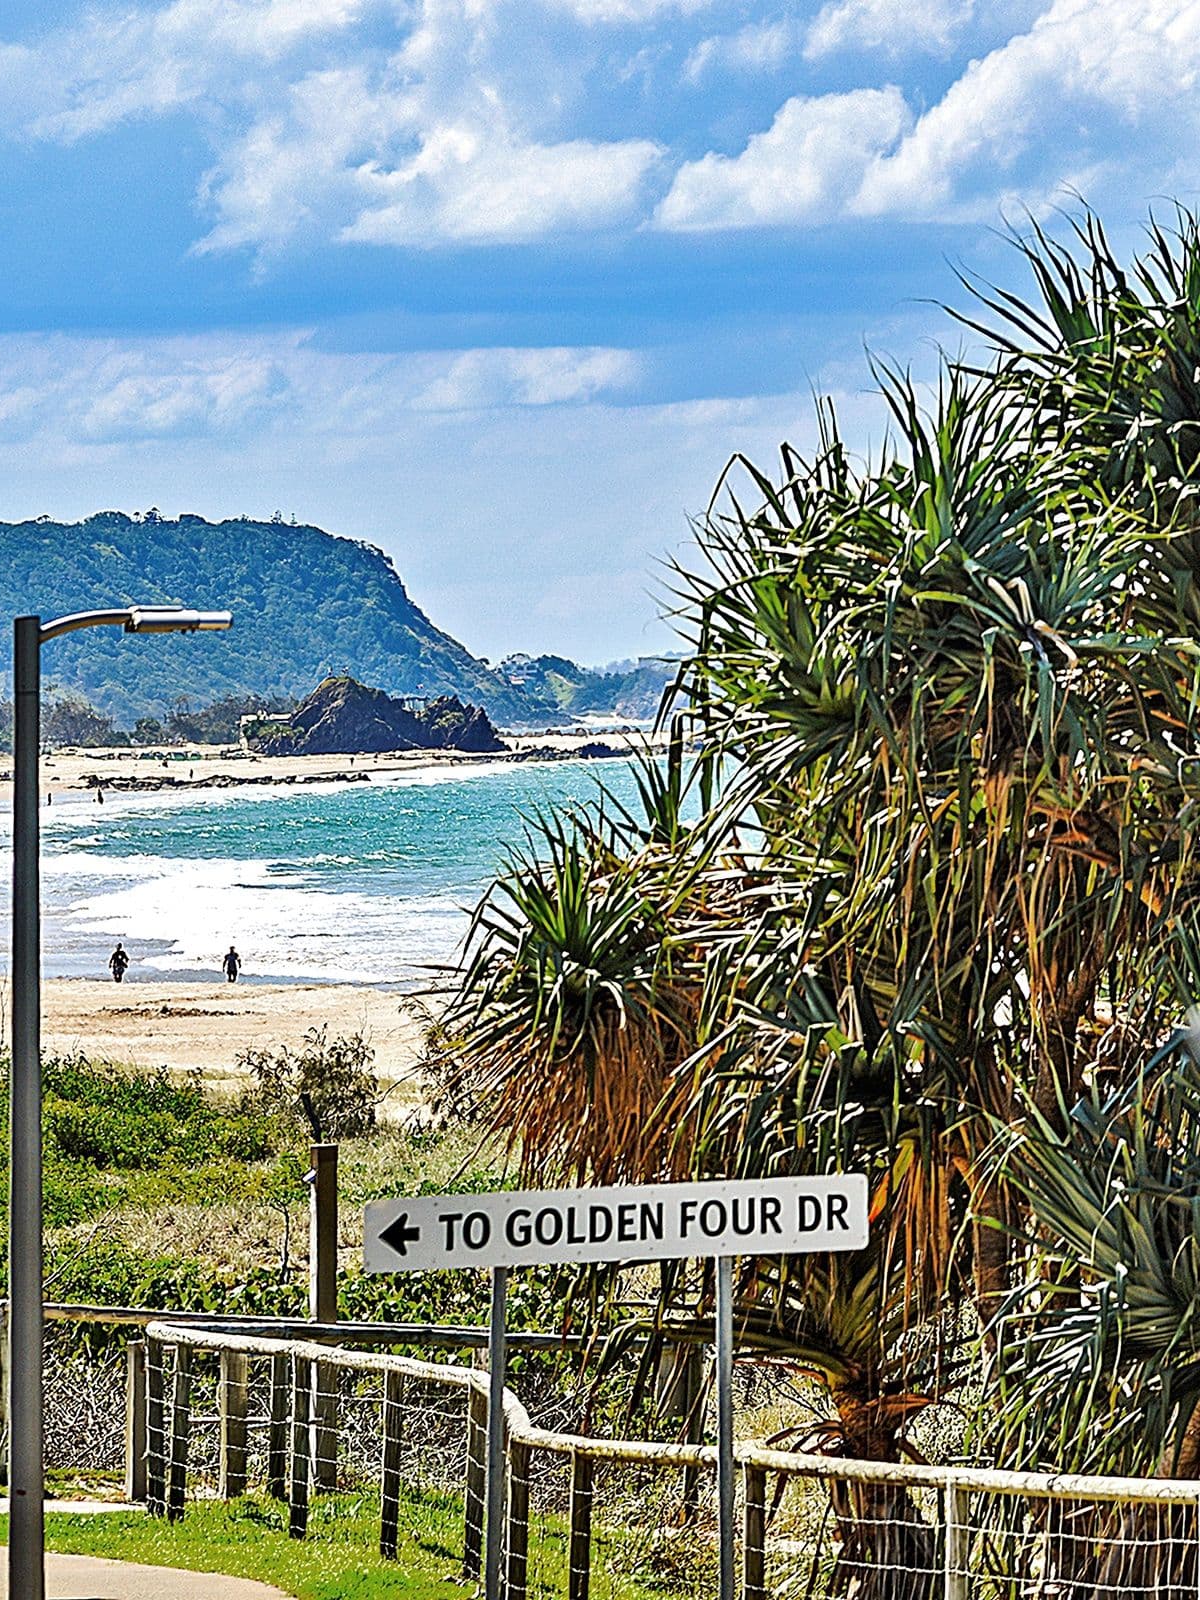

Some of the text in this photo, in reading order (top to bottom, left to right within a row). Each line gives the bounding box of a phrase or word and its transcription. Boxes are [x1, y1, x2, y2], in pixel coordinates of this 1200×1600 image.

[438, 1194, 851, 1252] TO GOLDEN FOUR DR
